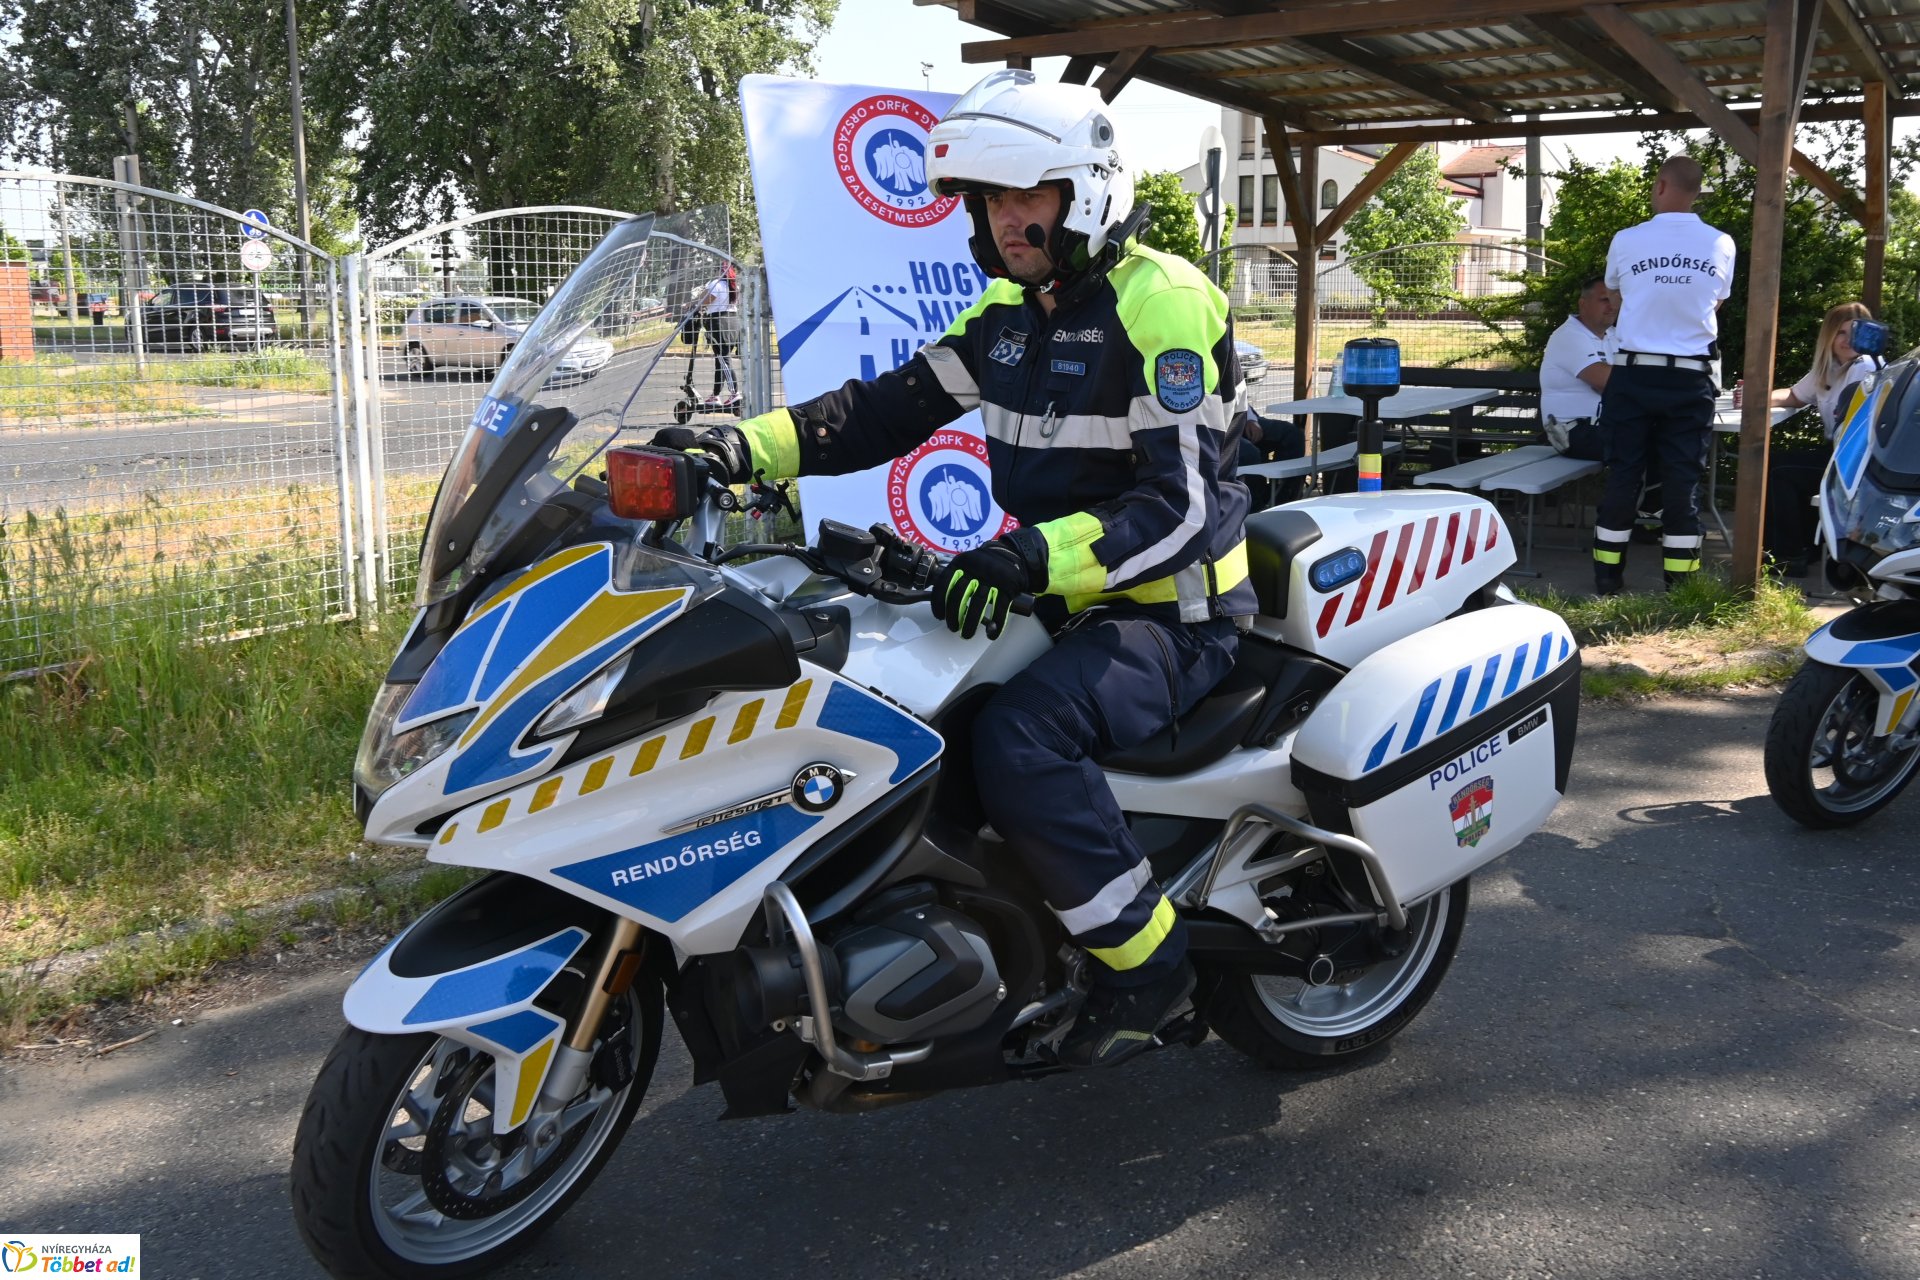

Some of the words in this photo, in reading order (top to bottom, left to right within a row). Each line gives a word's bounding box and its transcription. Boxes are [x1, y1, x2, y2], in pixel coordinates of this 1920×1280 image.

[876, 100, 909, 113] ORFK
[837, 107, 867, 171] ORSZÁGOS
[886, 195, 926, 207] 1992
[1631, 253, 1717, 277] RENDŐRSÉG
[1654, 275, 1692, 284] POLICE
[1163, 352, 1195, 363] POLICE
[928, 434, 963, 447] ORFK
[1517, 717, 1539, 737] BMW
[1429, 735, 1502, 791] POLICE
[796, 769, 836, 788] BMW
[611, 830, 762, 887] RENDŐRSÉG
